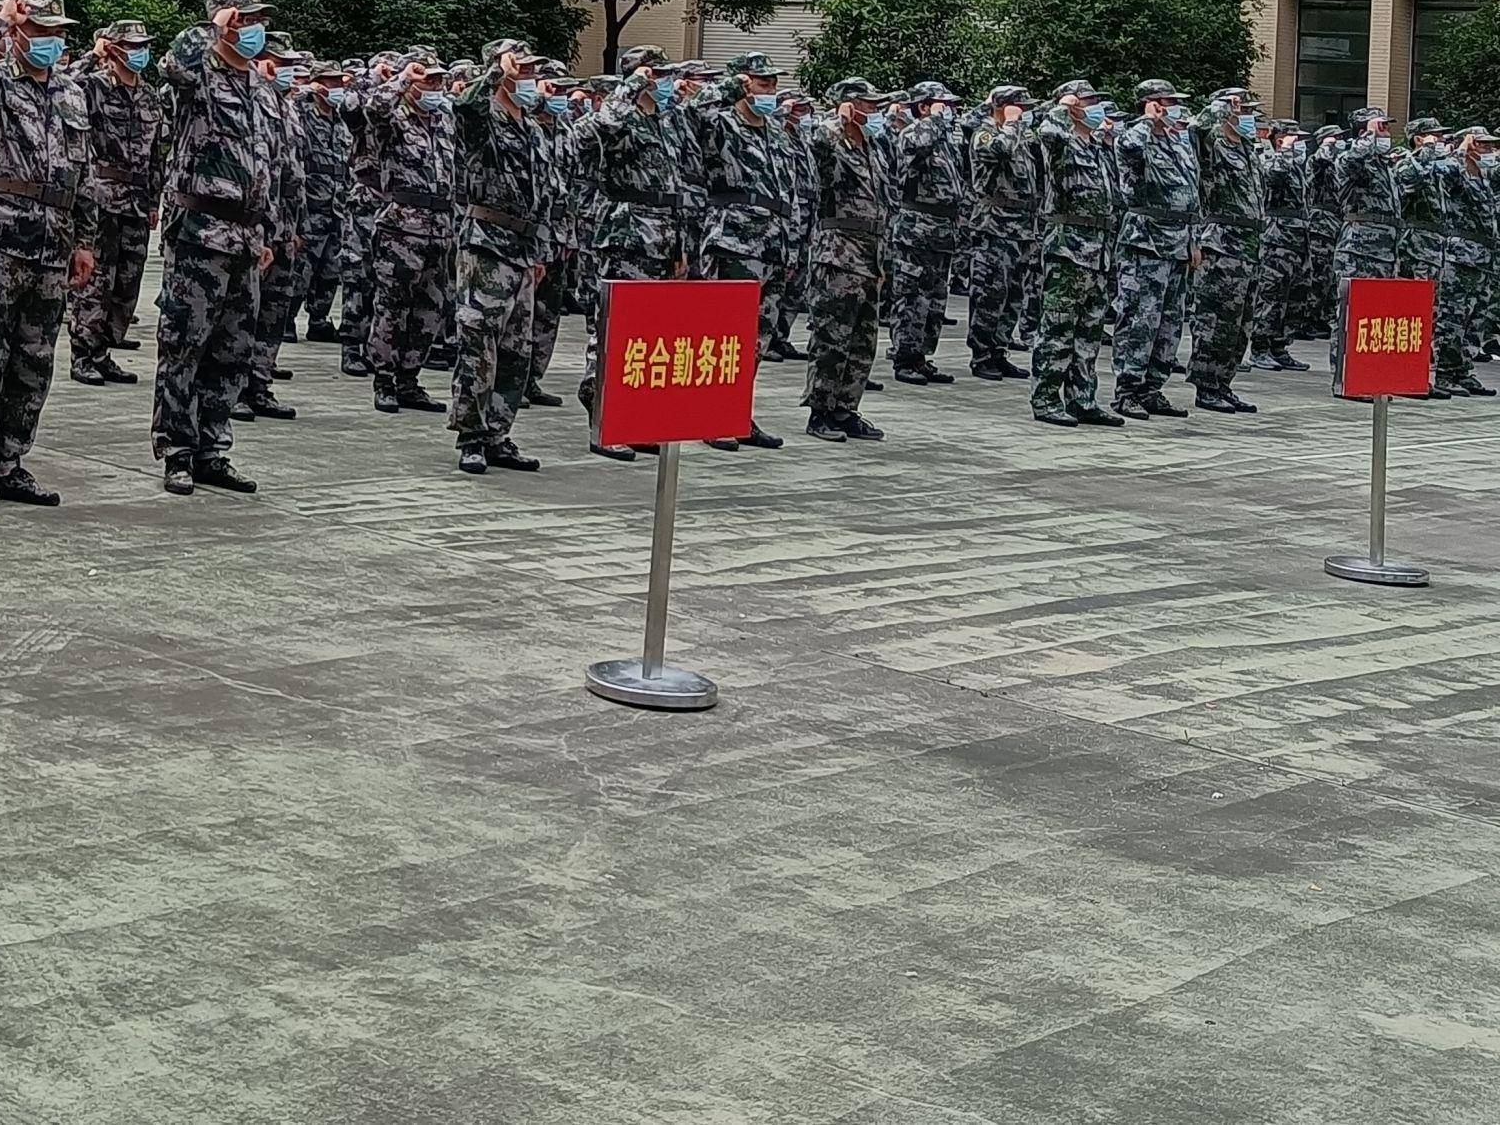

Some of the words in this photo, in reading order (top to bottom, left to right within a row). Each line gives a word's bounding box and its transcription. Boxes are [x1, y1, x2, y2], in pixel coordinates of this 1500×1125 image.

[1356, 316, 1423, 353] 反恐维稳排
[622, 335, 741, 389] 综合勤务排
